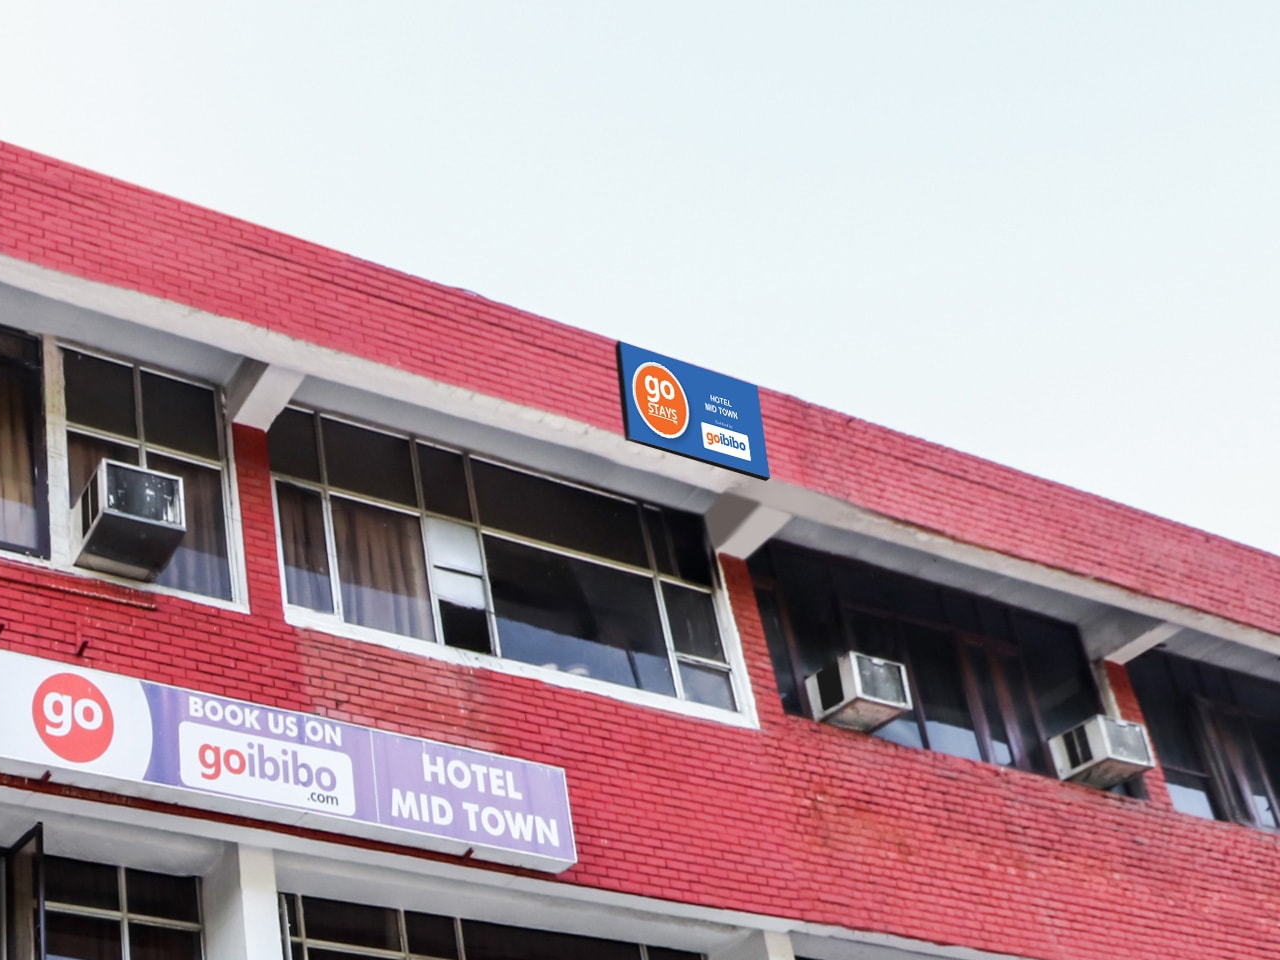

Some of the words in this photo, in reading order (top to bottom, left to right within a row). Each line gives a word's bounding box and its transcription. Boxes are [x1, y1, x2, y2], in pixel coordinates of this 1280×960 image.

[644, 375, 675, 403] go
[710, 394, 732, 408] HOTEL
[648, 402, 678, 421] STAYS
[718, 406, 738, 420] TOWN
[706, 432, 746, 451] goibibo
[42, 691, 104, 737] go
[188, 695, 262, 731] BOOK
[268, 711, 299, 739] US
[305, 718, 343, 747] ON
[198, 741, 337, 793] goibibo
[421, 753, 522, 801] HOTEL
[307, 790, 339, 807] .com
[391, 788, 454, 827] MID
[462, 806, 560, 848] TOWN
